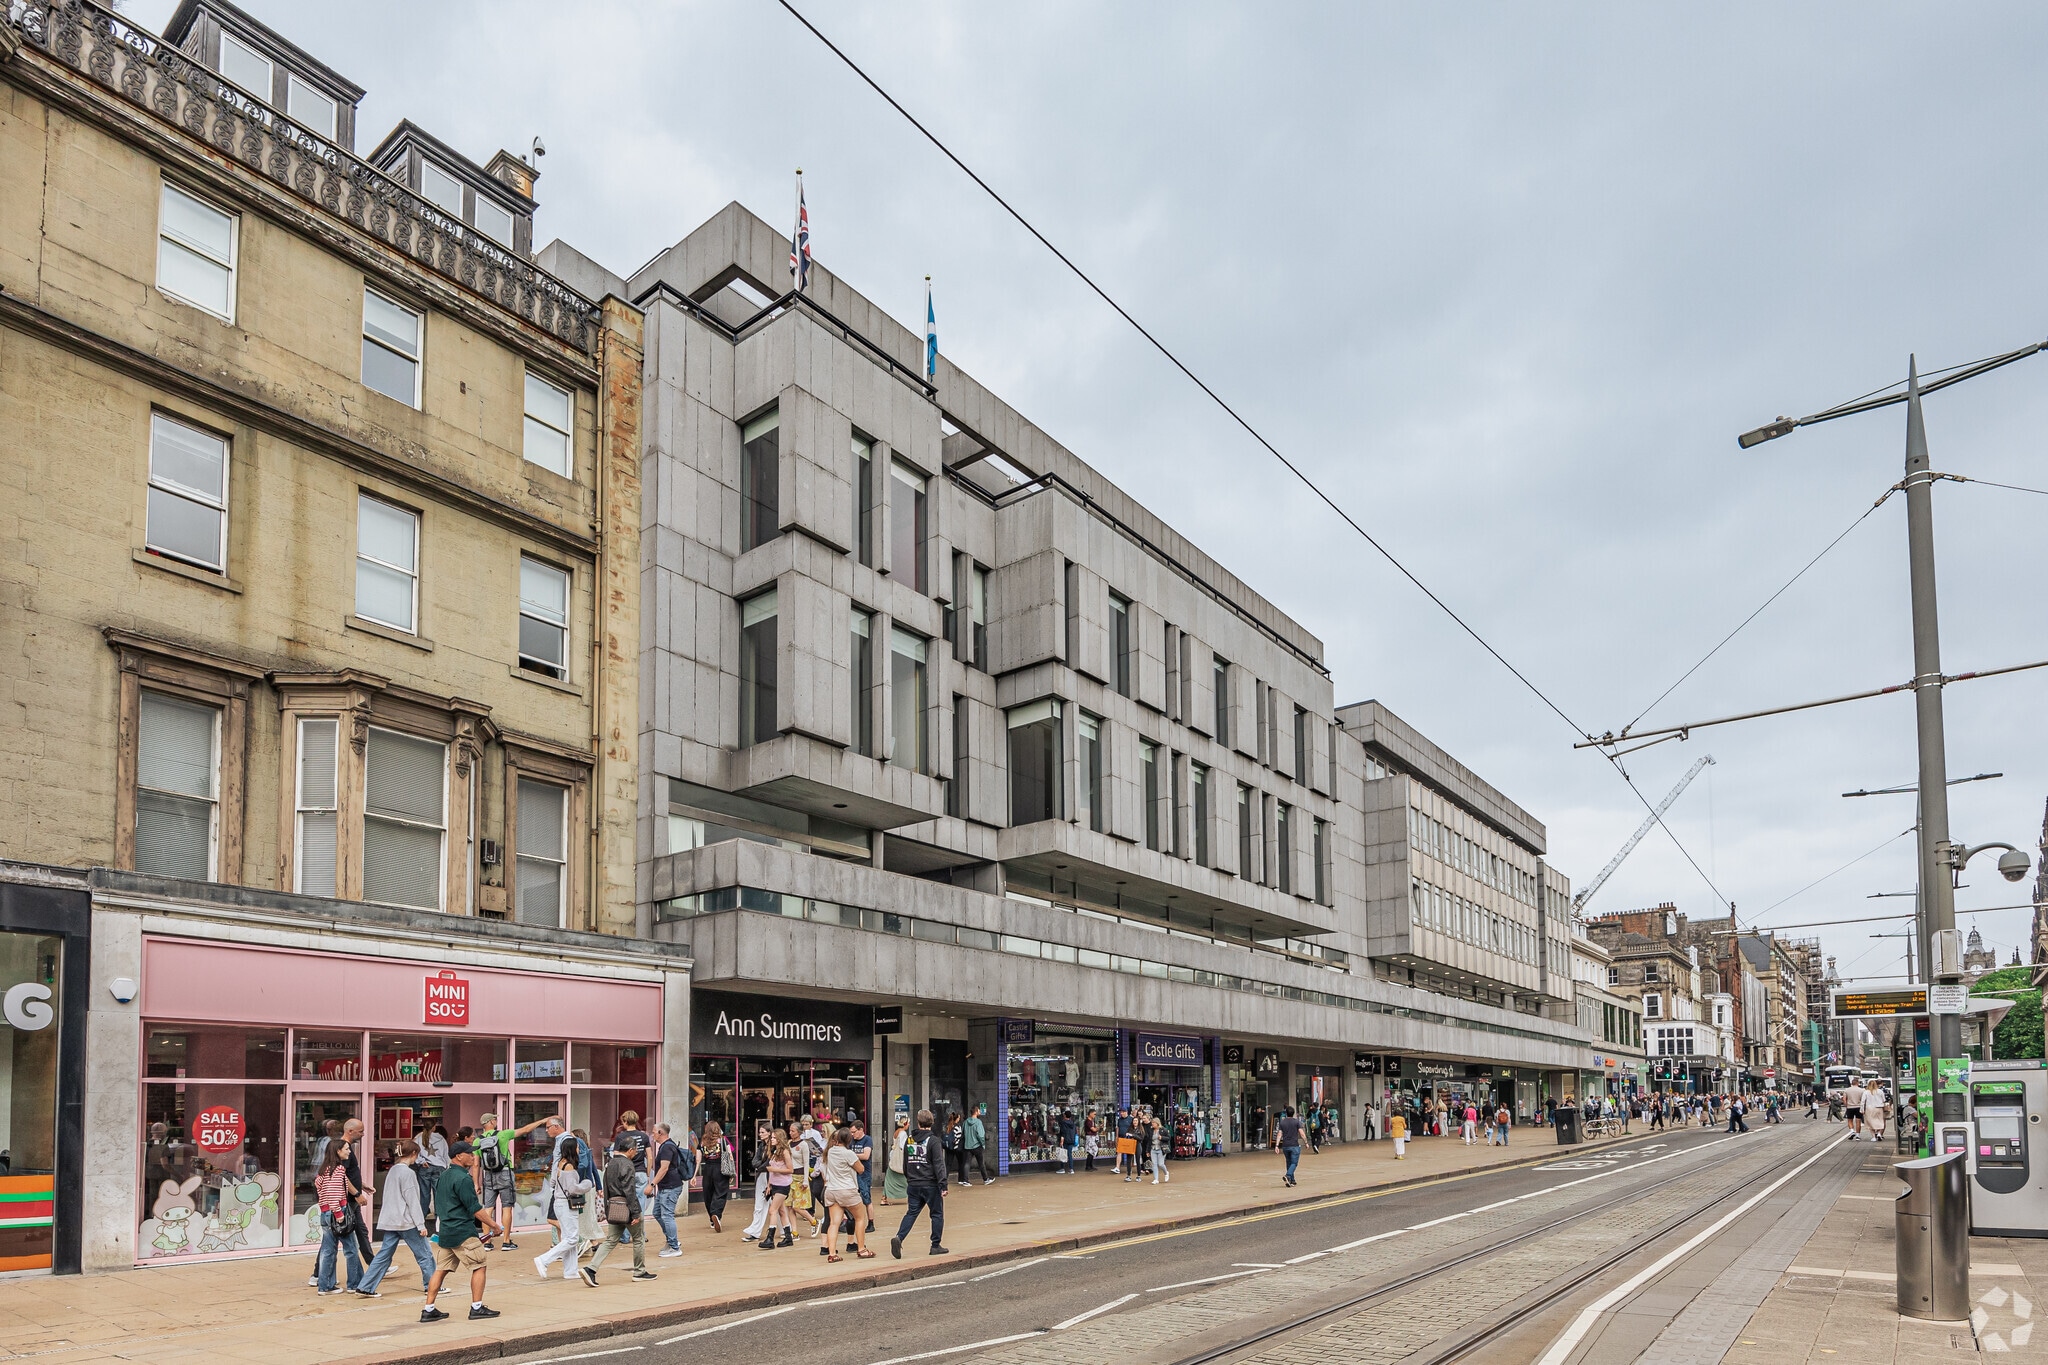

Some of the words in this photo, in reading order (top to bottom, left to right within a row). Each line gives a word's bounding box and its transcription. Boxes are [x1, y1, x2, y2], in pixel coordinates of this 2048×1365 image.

[429, 984, 465, 1000] MINI
[3, 983, 54, 1030] G
[714, 1010, 755, 1037] Ann
[760, 1013, 842, 1042] Summers
[1008, 1023, 1028, 1031] Castle
[1010, 1032, 1026, 1040] Gifts
[1145, 1042, 1173, 1058] Castle
[1175, 1044, 1196, 1059] Gifts
[1417, 1062, 1448, 1078] Superdrug
[200, 1113, 239, 1124] SALE
[200, 1129, 239, 1146] 50%
